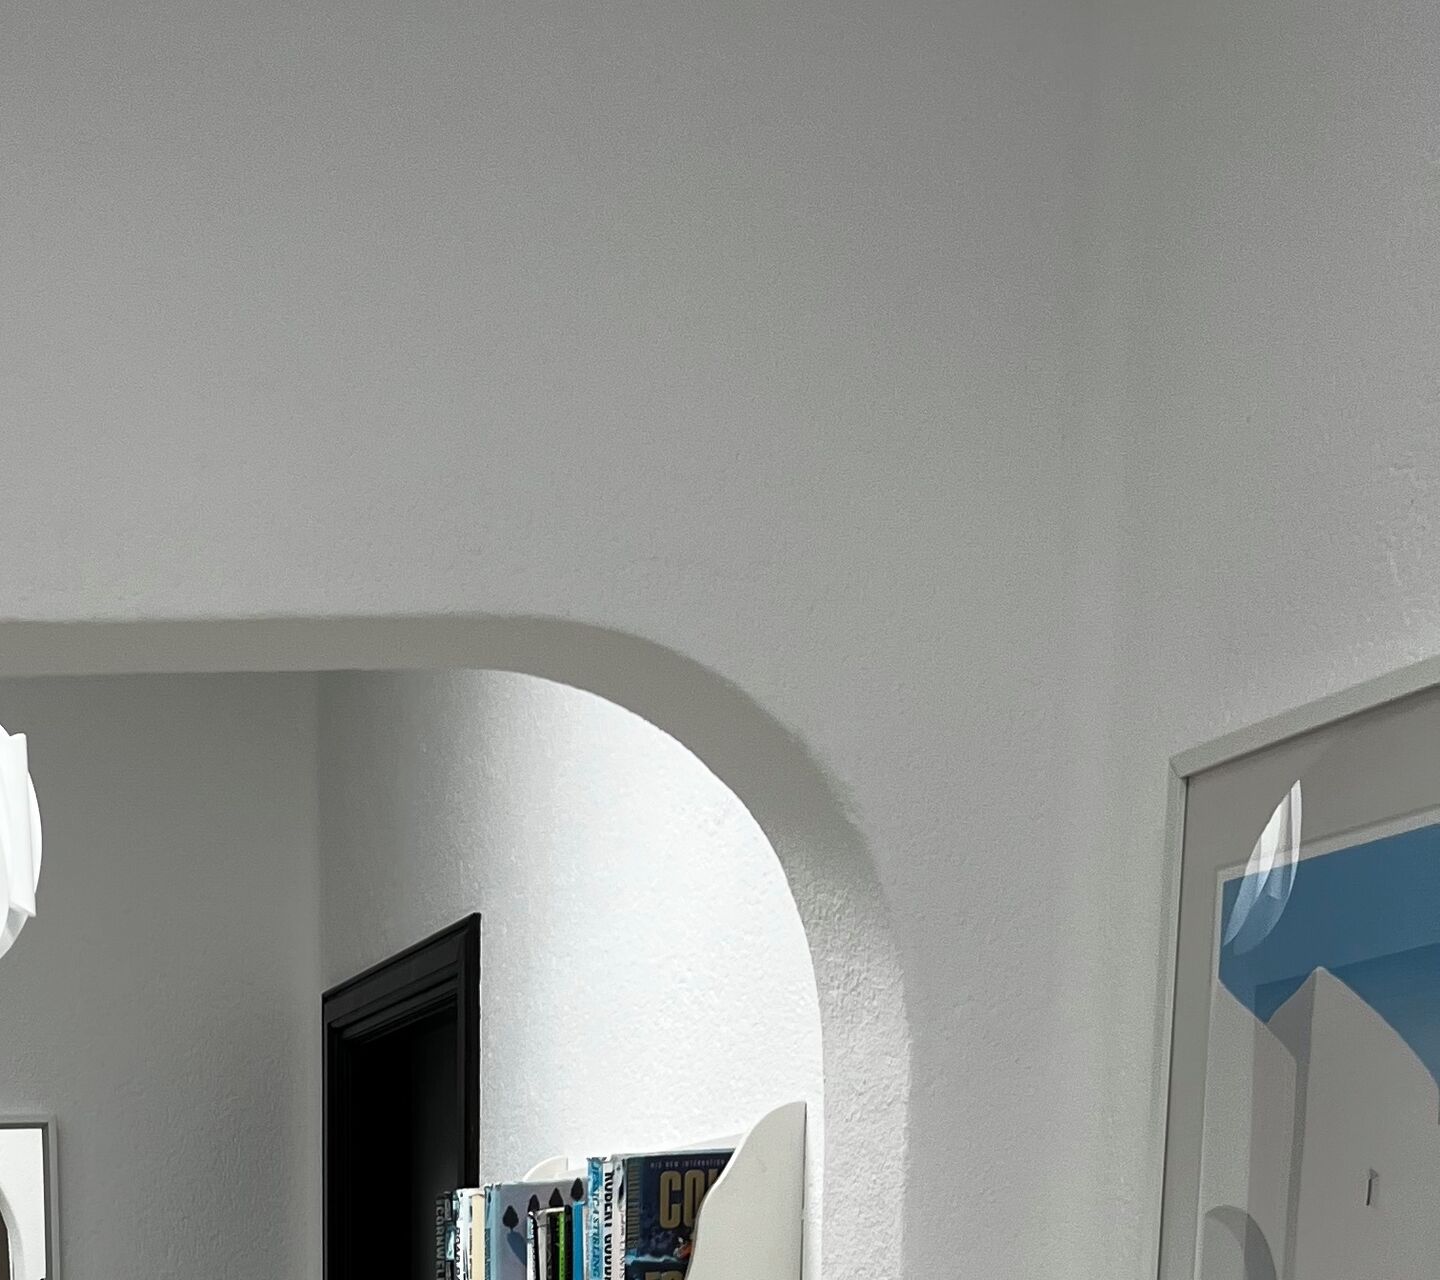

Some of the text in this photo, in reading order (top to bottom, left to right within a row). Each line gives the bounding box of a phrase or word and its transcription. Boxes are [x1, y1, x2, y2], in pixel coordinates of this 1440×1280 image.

[592, 1164, 601, 1278] JESSICA STIRLING
[660, 1169, 718, 1228] CO
